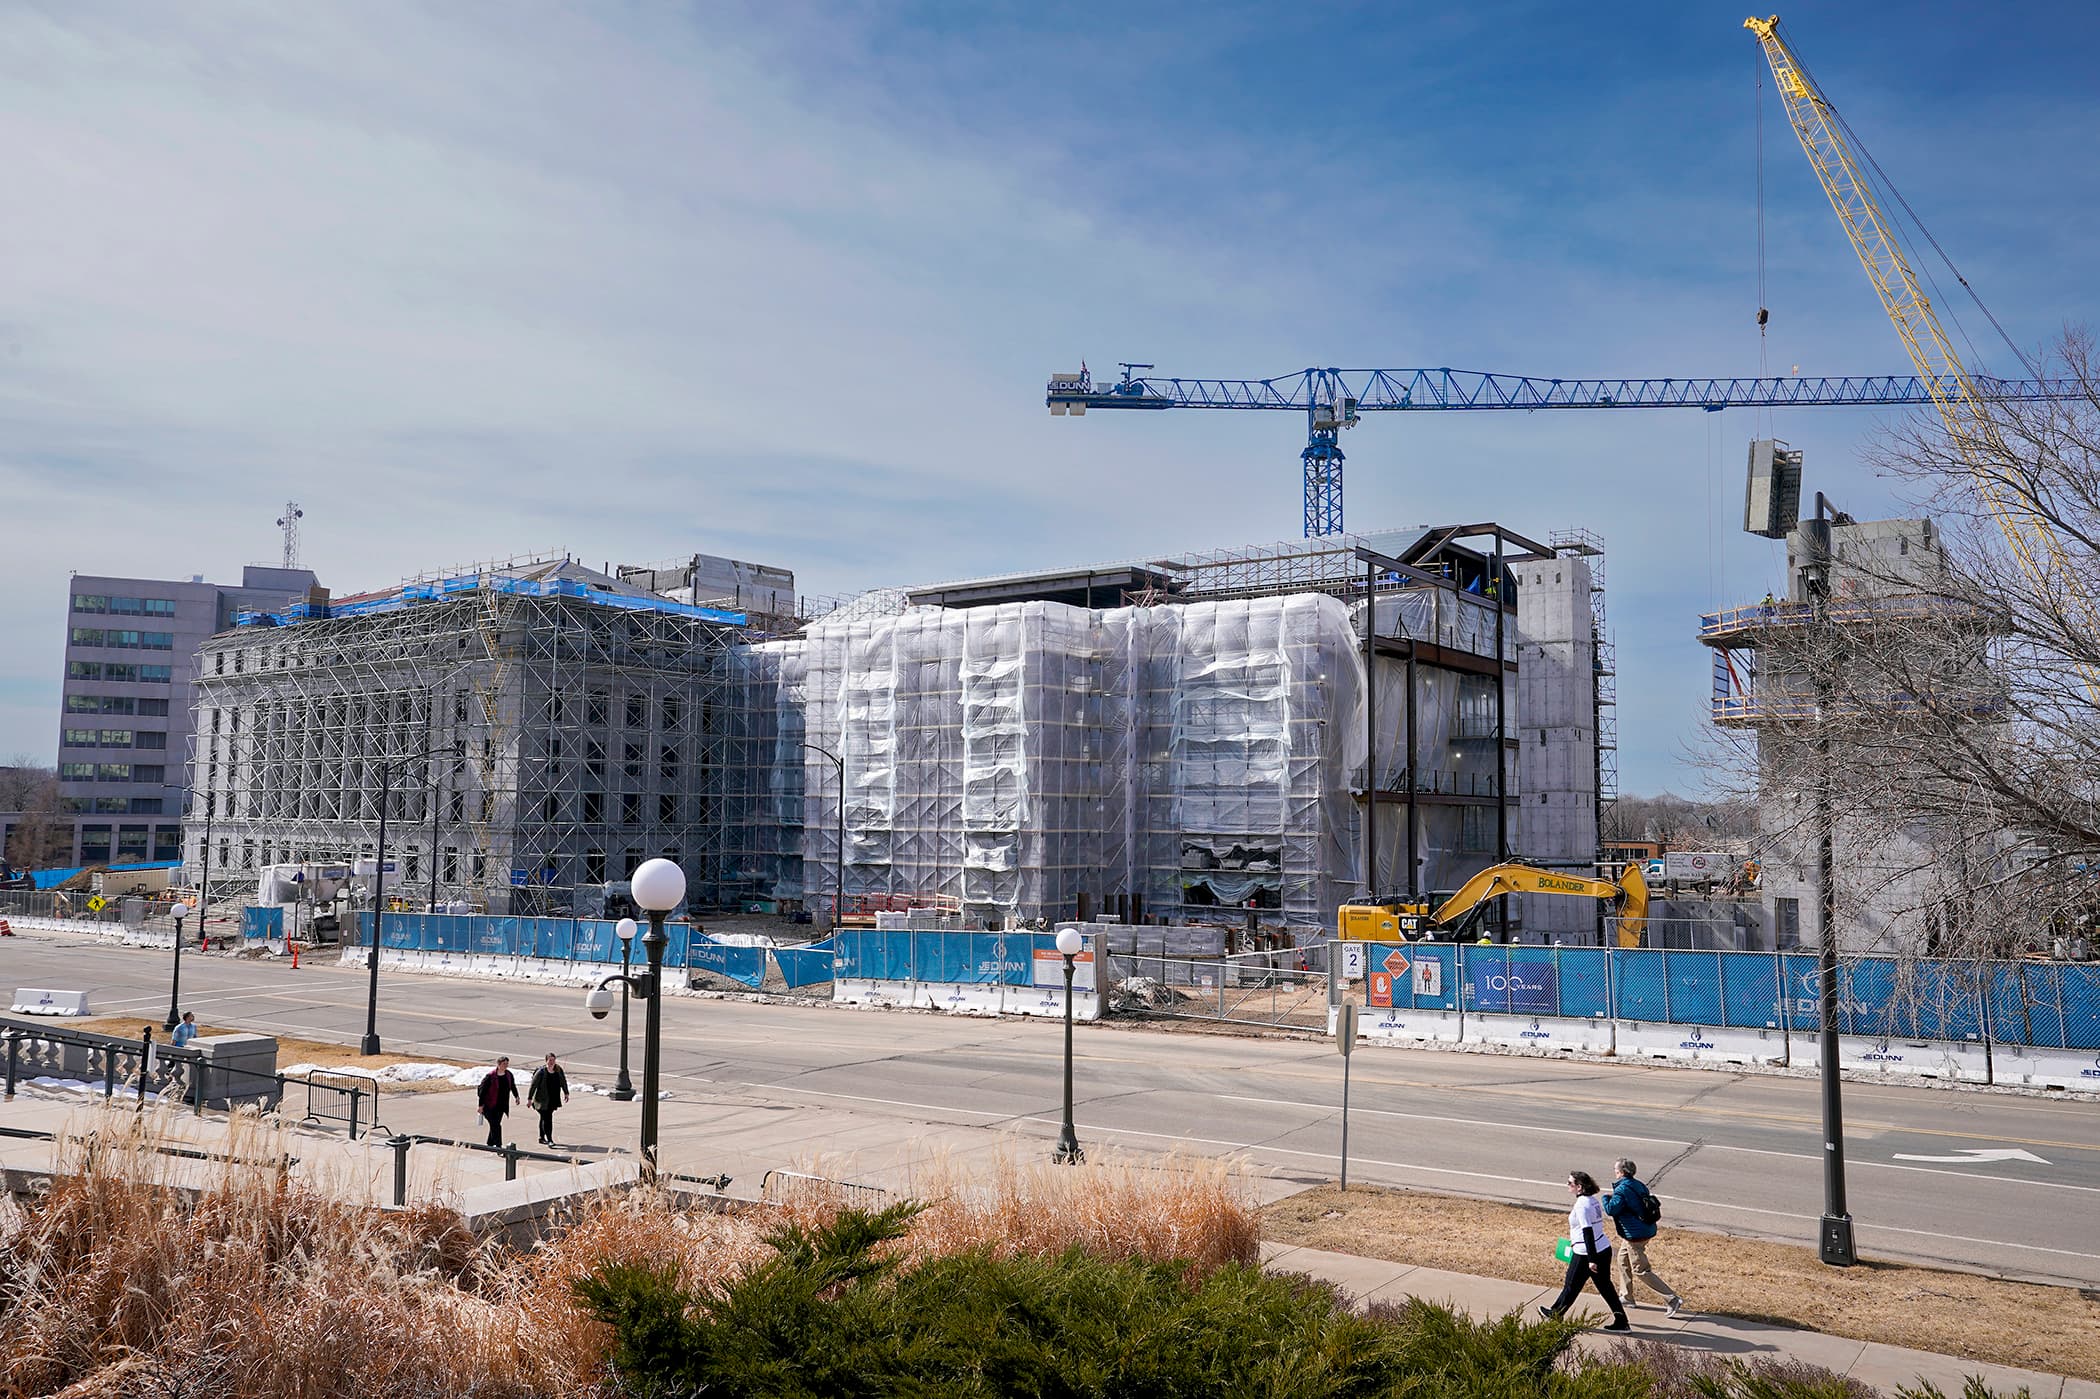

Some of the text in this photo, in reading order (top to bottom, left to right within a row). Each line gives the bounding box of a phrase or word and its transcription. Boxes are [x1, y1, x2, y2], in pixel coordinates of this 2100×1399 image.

[1538, 877, 1585, 892] BOLANDER
[1401, 918, 1418, 929] CAT
[1350, 954, 1357, 966] 2
[1485, 975, 1523, 991] 100
